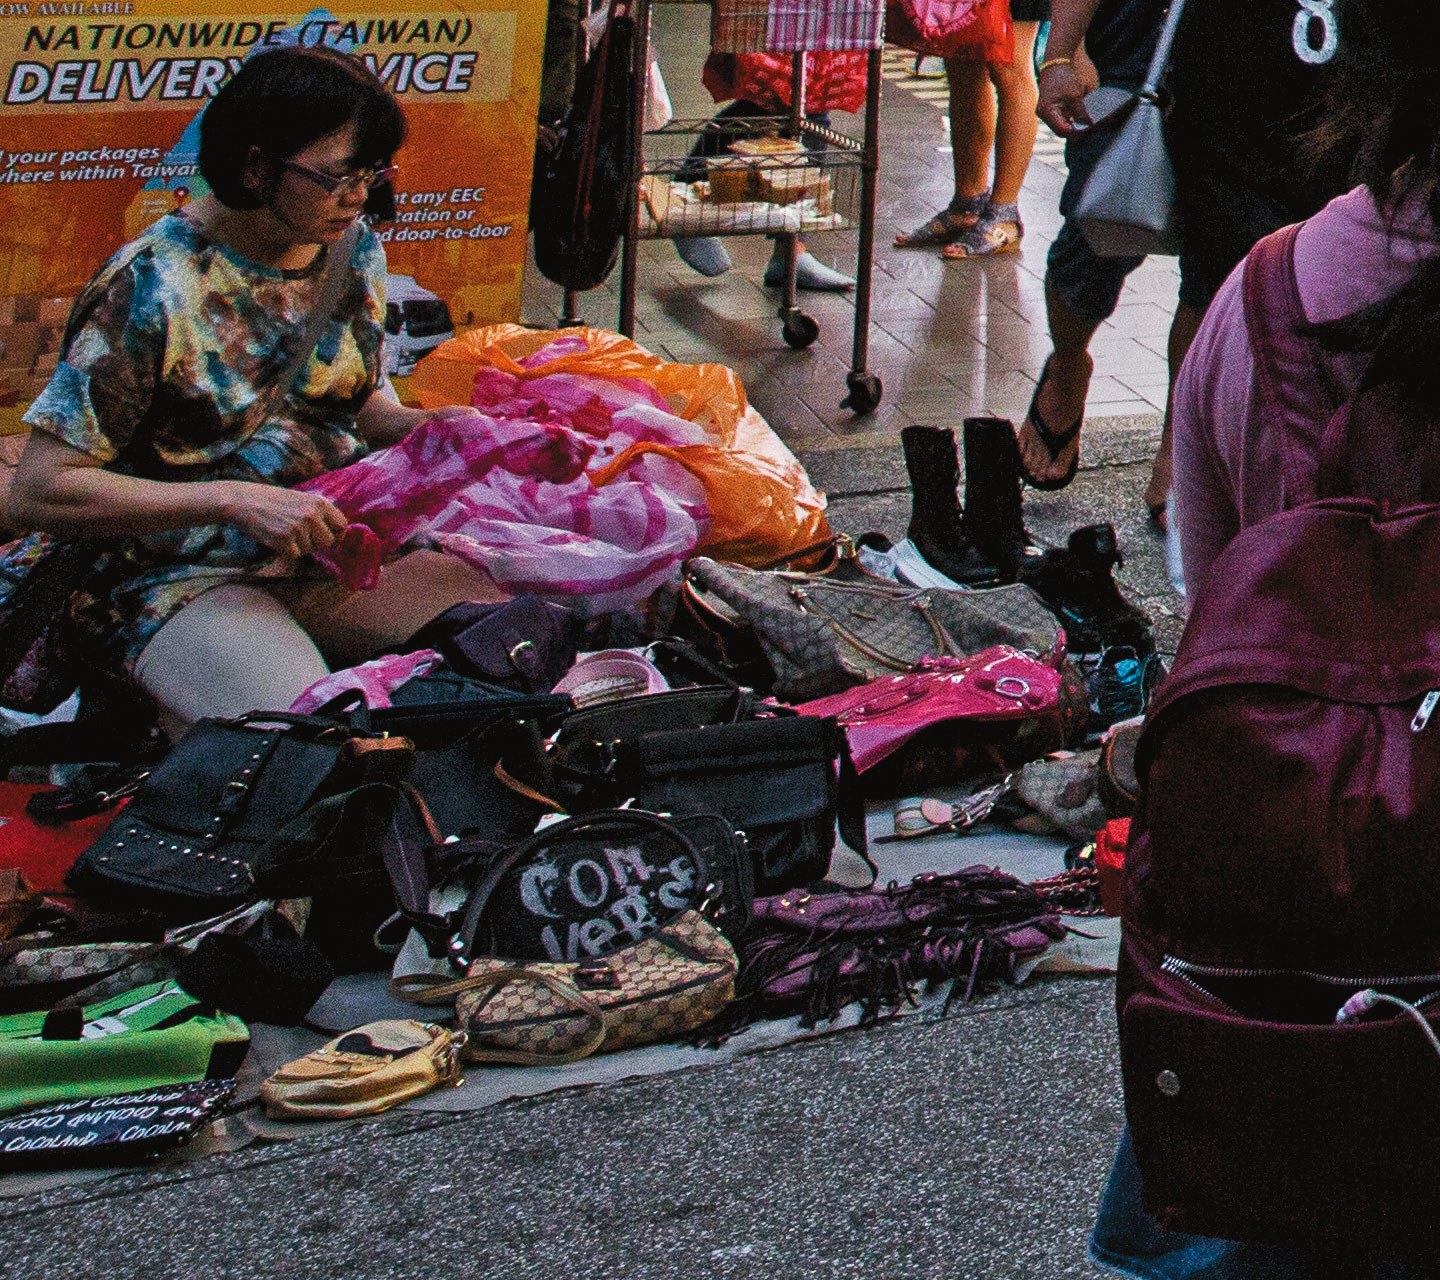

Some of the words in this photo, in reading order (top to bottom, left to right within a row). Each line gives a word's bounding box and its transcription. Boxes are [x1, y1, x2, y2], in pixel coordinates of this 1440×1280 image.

[23, 21, 288, 52] NATIONWIDE
[299, 17, 473, 47] (TAIWAN)
[7, 151, 56, 167] your
[60, 146, 160, 165] packages
[58, 164, 125, 180] within
[450, 187, 485, 202] EEC
